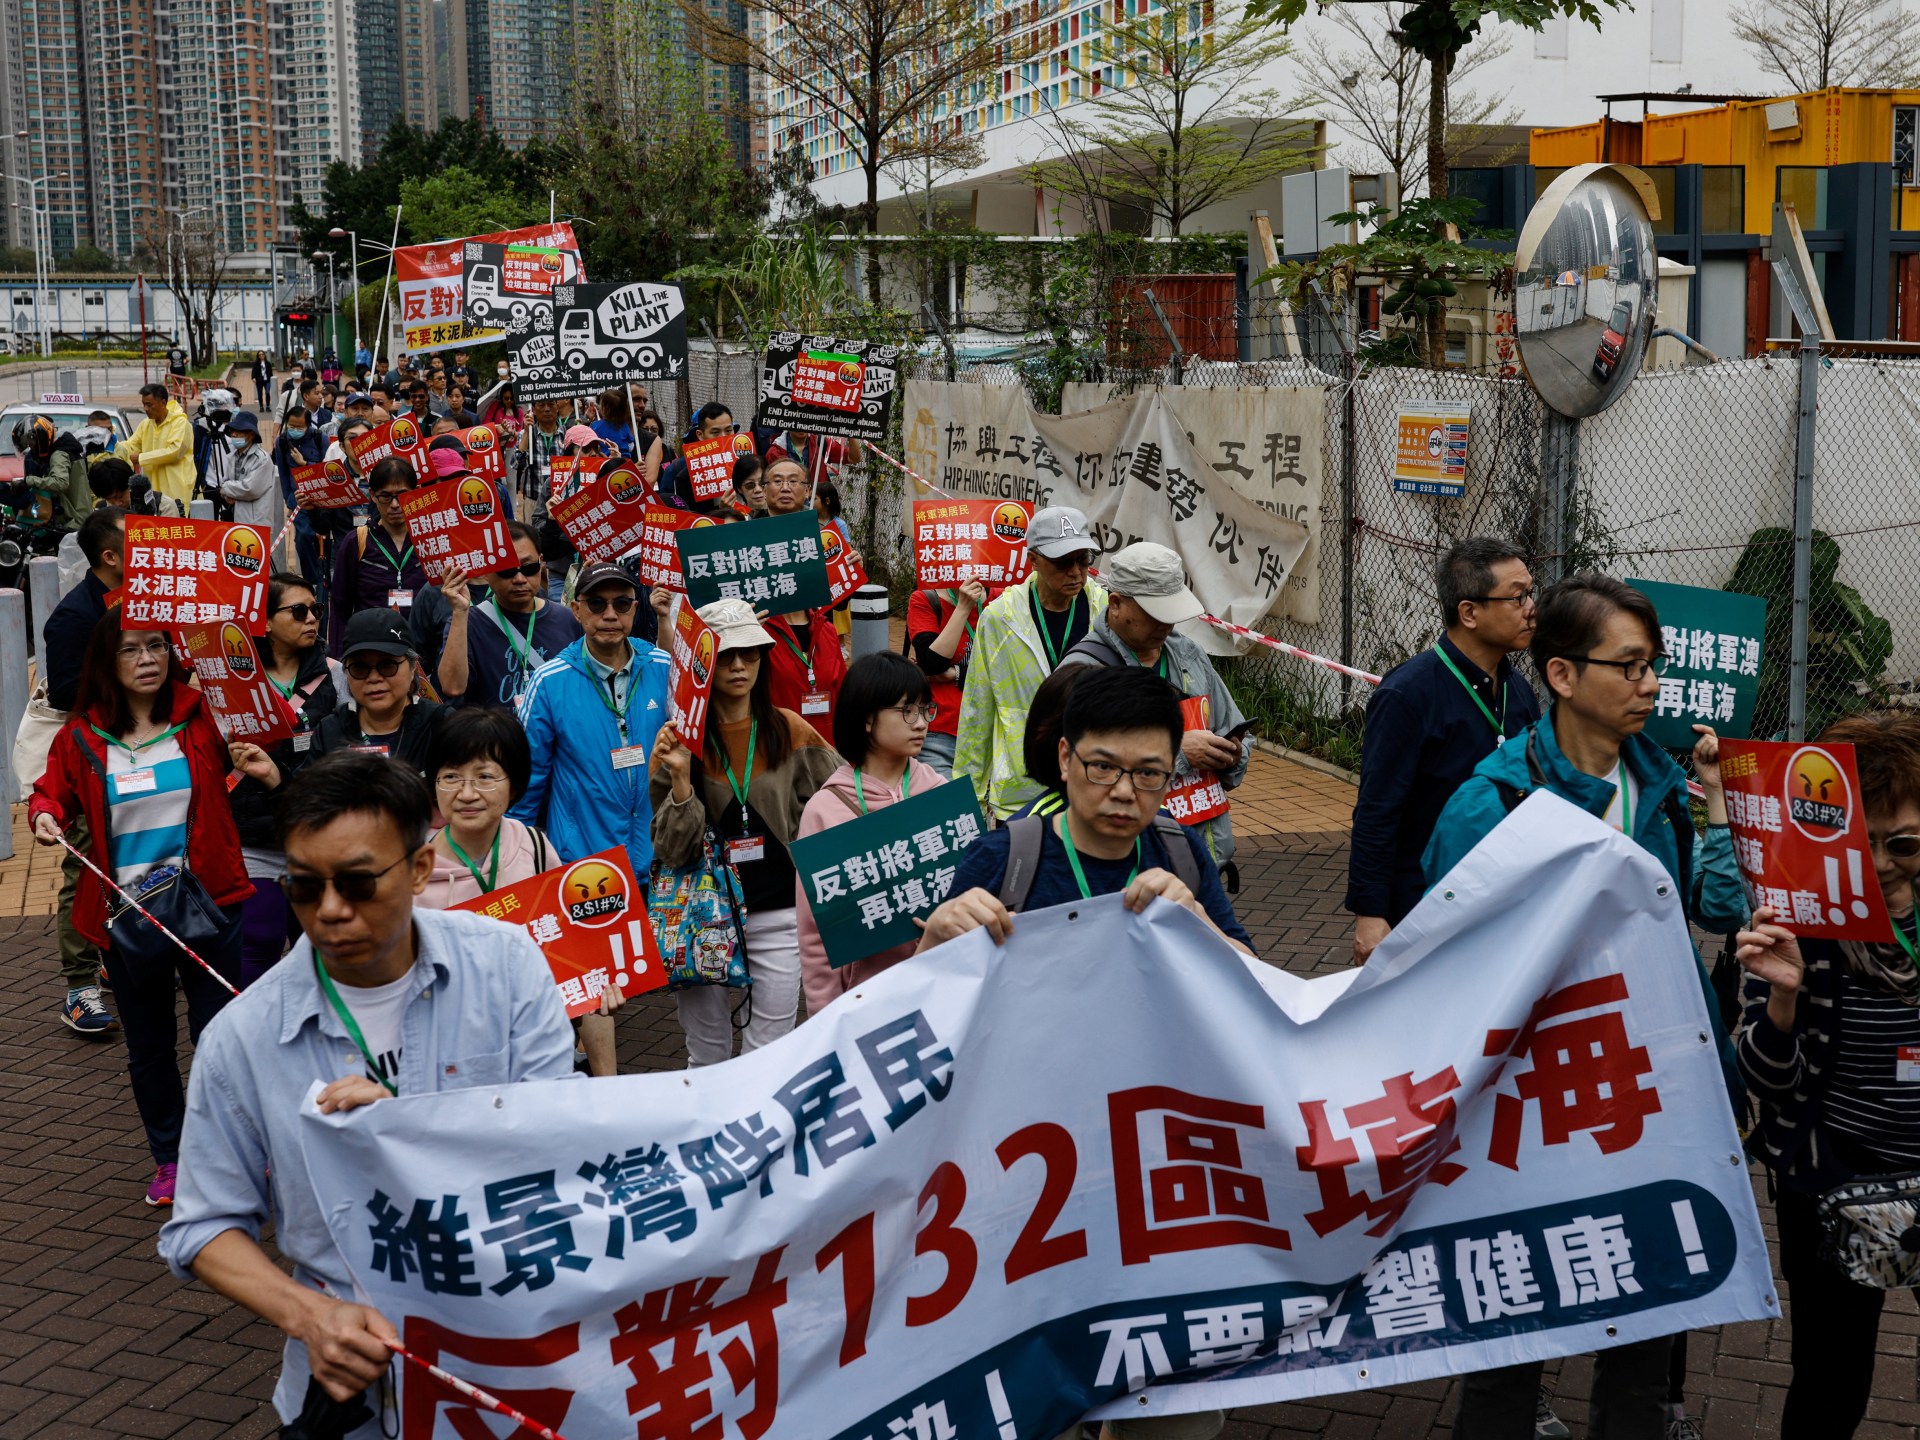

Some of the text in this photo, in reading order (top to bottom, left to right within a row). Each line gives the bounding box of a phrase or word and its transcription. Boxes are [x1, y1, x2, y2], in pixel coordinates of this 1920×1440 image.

[609, 287, 669, 314] KILL THE
[609, 304, 671, 337] PLANT
[526, 338, 548, 353] KILL
[815, 340, 831, 349] PLANT
[527, 348, 555, 365] PLAN
[579, 368, 662, 381] before it kills us!
[796, 378, 825, 391] 水泥廠
[797, 366, 836, 381] 反對興建
[44, 394, 80, 403] TAXI
[519, 394, 532, 402] END
[533, 392, 549, 401] Govt
[549, 389, 577, 399] inaction
[521, 383, 534, 391] END
[794, 389, 842, 406] 垃圾處理廠
[863, 380, 892, 394] LANT
[768, 407, 783, 416] END
[783, 409, 856, 425] Environment/labour
[762, 418, 884, 440] END Govt inaction on illegal plant!
[358, 443, 393, 469] 反對興建
[551, 460, 586, 470] 將軍澳民
[689, 451, 733, 471] 反對興建
[1187, 431, 1308, 489] 工程
[692, 467, 727, 483] 水泥廠
[943, 466, 963, 490] HIP
[963, 468, 991, 495] HING
[695, 479, 733, 497] 垃圾處
[403, 490, 439, 516] 將軍澳居民
[915, 503, 970, 523] 將軍澳居民
[408, 508, 460, 537] 反對興建
[564, 500, 617, 538] 反對興建
[1058, 514, 1081, 539] A
[127, 525, 196, 543] 將軍澳居民
[575, 522, 616, 551] 水泥廠
[643, 526, 678, 548] 反對興
[918, 523, 989, 542] 反對興建
[416, 534, 452, 558] 水泥廠
[642, 544, 673, 566] 水泥廠
[919, 543, 973, 562] 水泥廠
[129, 546, 218, 572] 反對興建
[688, 536, 820, 580] 反對將軍澳
[641, 562, 686, 589] 垃圾處理
[920, 564, 1005, 583] 垃圾處理廠
[128, 573, 198, 598] 水泥廠
[717, 572, 798, 602] 再填海
[126, 601, 236, 625] 垃圾處理廠
[1654, 677, 1738, 723] 再填海
[1724, 788, 1783, 834] 反對興建
[811, 812, 982, 905] 反對將軍澳
[856, 864, 957, 931] 再填海
[1823, 847, 1870, 927] !!
[608, 919, 648, 988] !!
[366, 1008, 955, 1299] 維景灣畔居民
